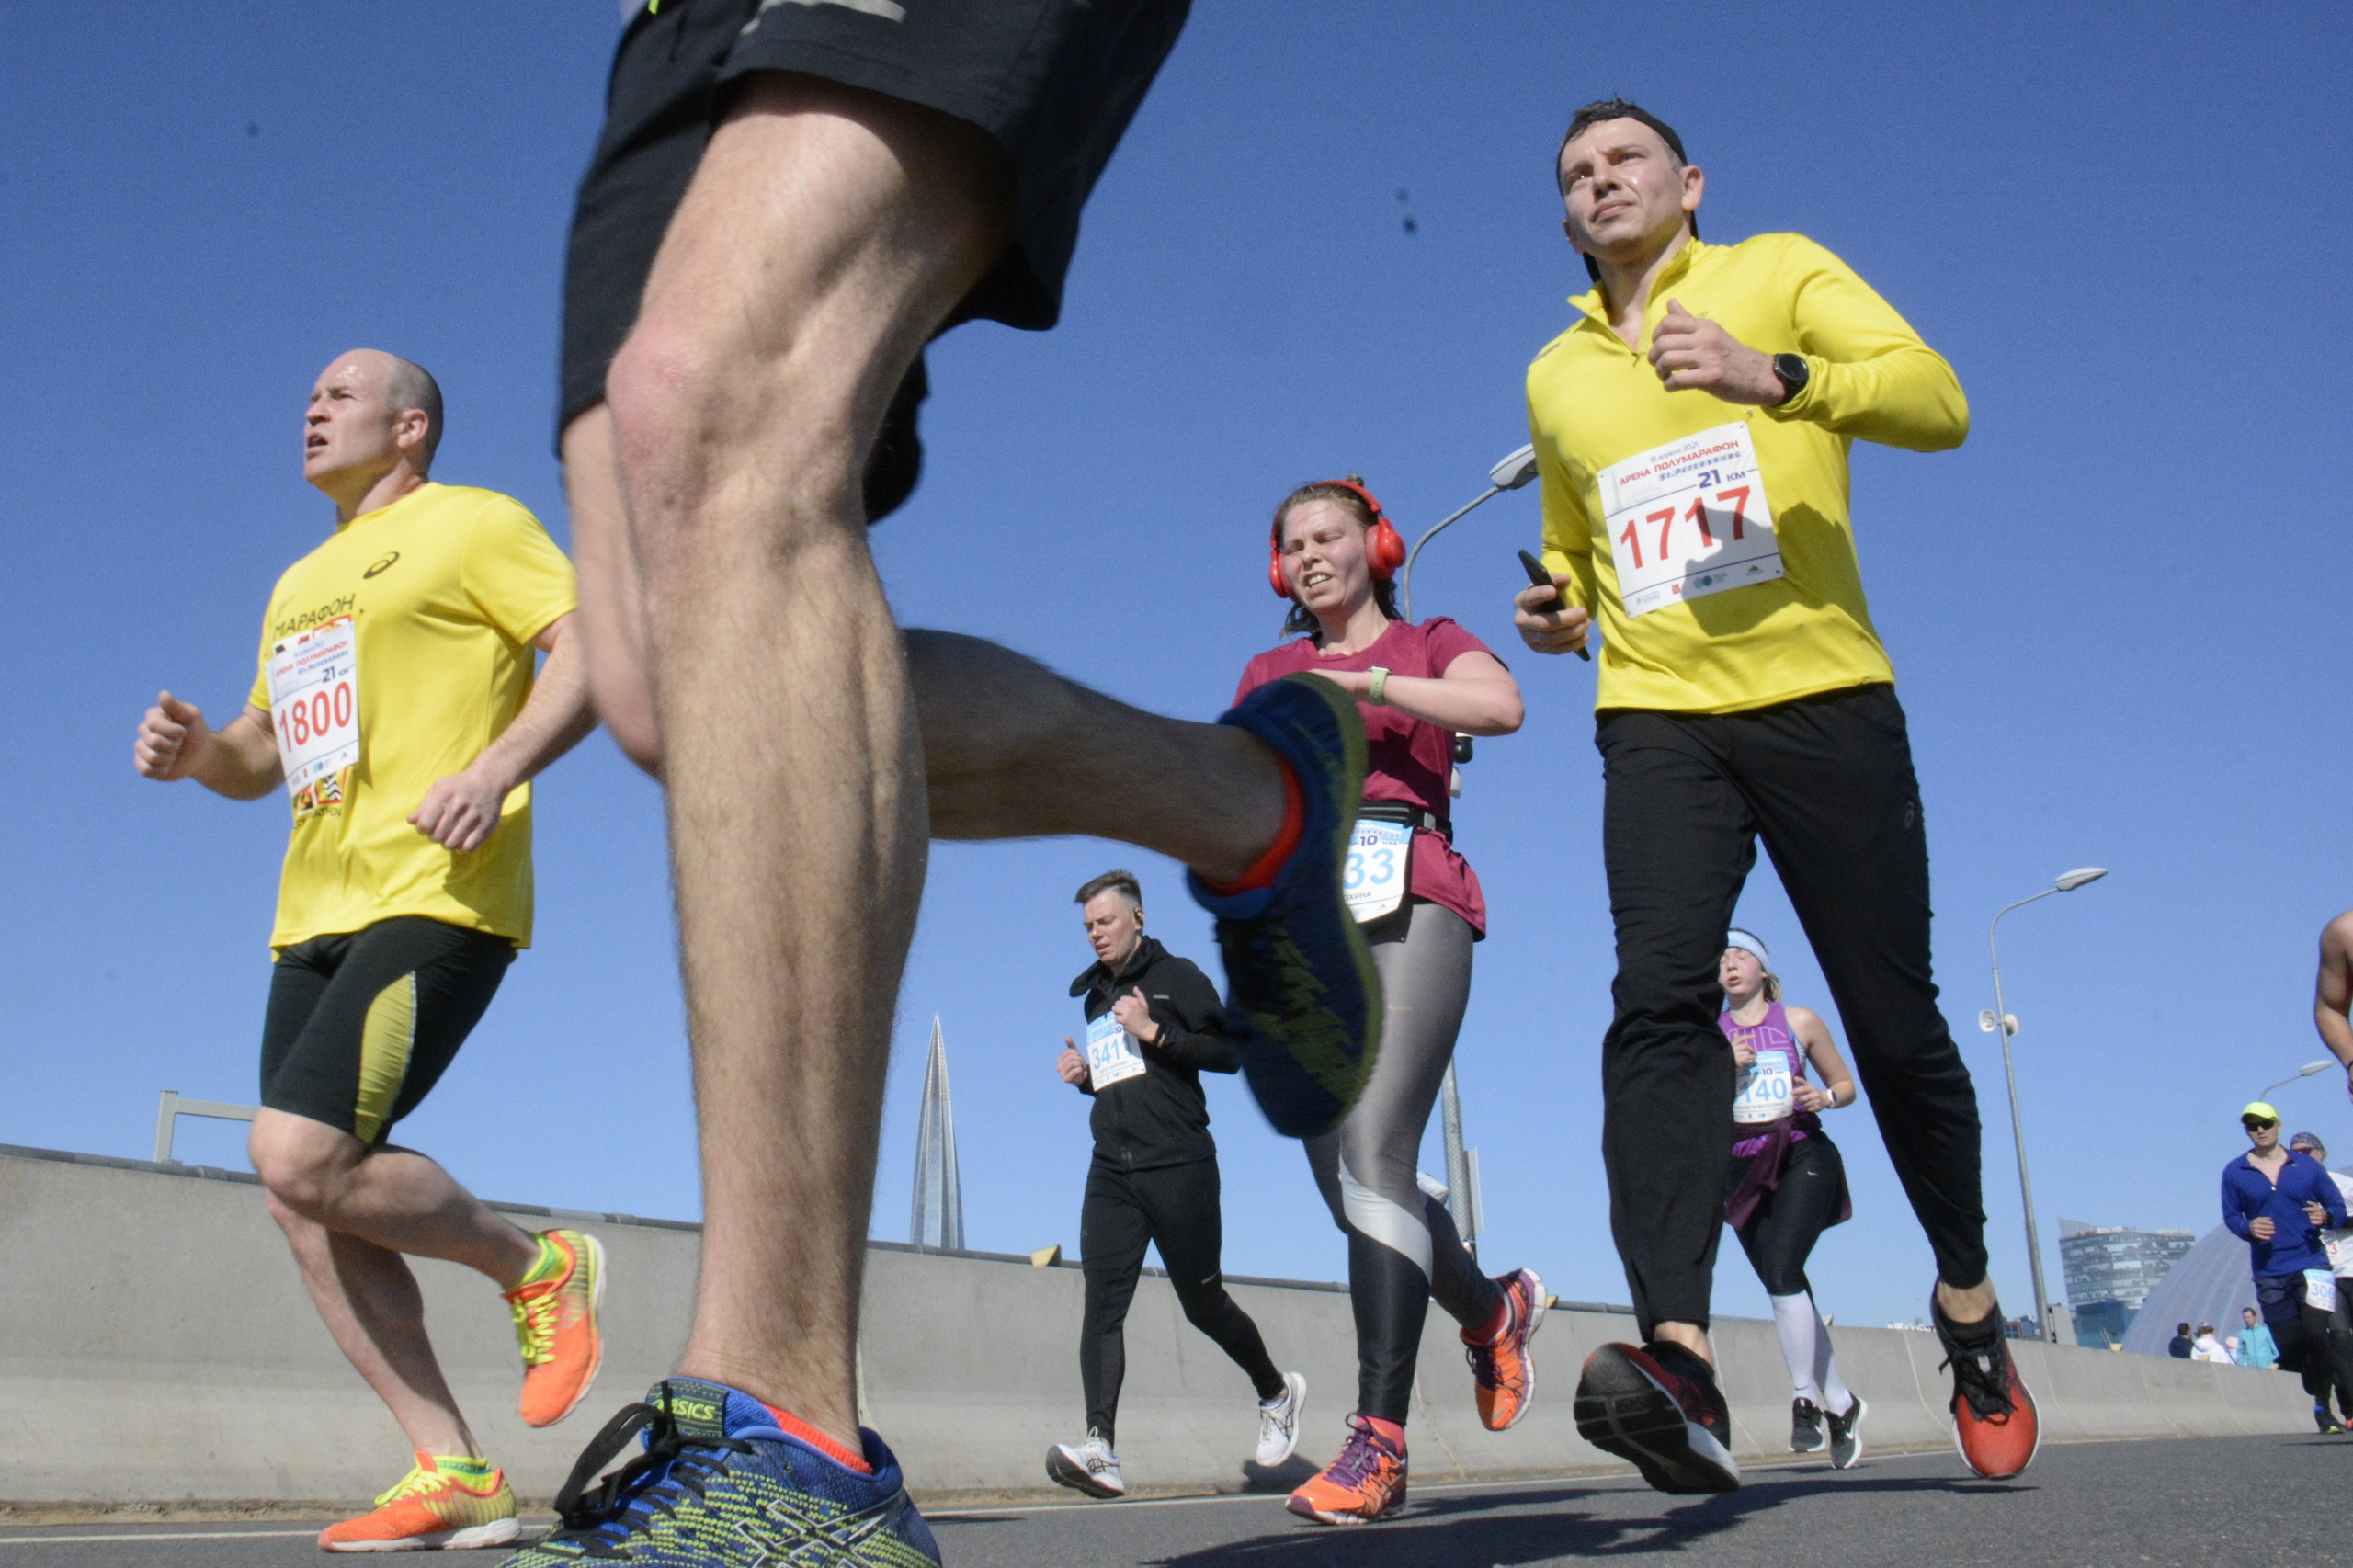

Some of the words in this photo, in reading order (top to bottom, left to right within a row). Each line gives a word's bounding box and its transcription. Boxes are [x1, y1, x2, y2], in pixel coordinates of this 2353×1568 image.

[1620, 468, 1651, 486] АРЕНА
[1654, 440, 1739, 473] ПОЛУМАРАФОН
[1698, 469, 1722, 489] 21
[1726, 471, 1745, 482] КМ
[1620, 485, 1751, 569] 1717
[273, 593, 356, 642] МАРАФОН
[322, 665, 336, 683] 21
[279, 681, 352, 753] 1800
[1359, 835, 1379, 846] 10
[1762, 1067, 1773, 1076] 10
